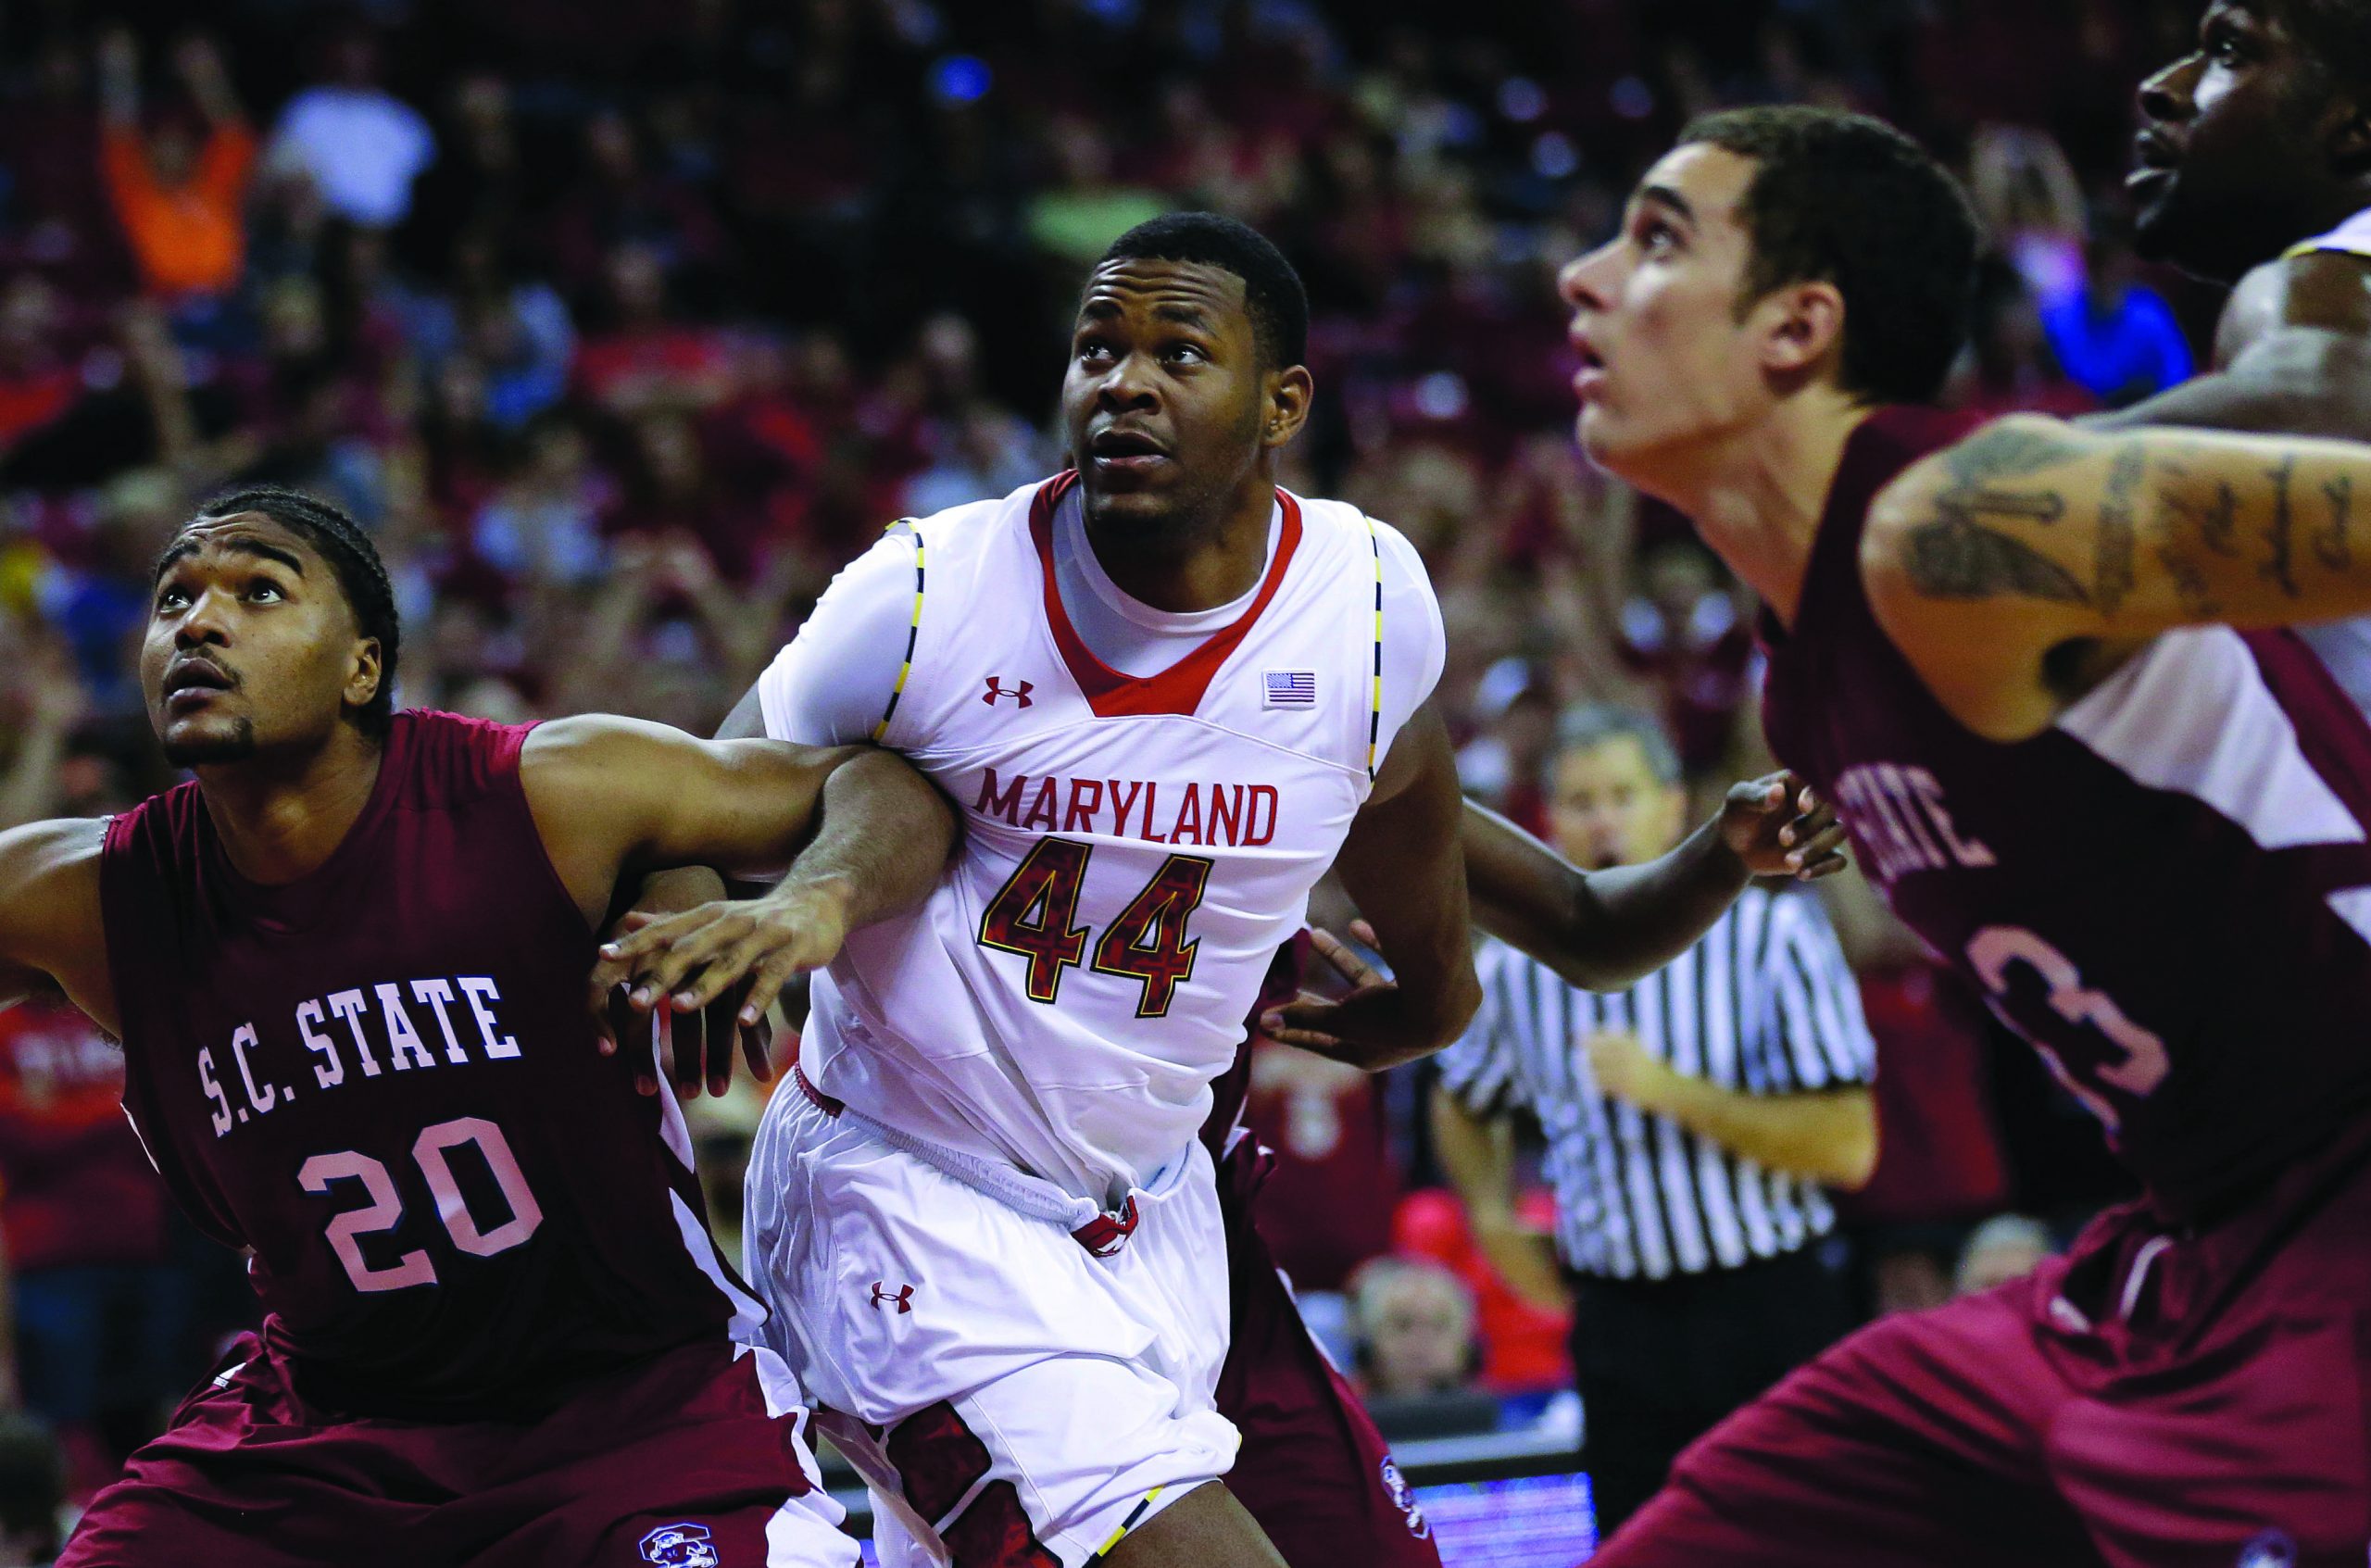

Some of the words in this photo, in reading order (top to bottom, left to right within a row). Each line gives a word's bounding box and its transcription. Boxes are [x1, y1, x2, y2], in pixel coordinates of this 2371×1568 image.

[972, 767, 1279, 847] MARYLAND
[976, 834, 1215, 1019] 44
[196, 1022, 296, 1137] S.C.
[295, 976, 522, 1089] STATE
[296, 1116, 545, 1293] 20
